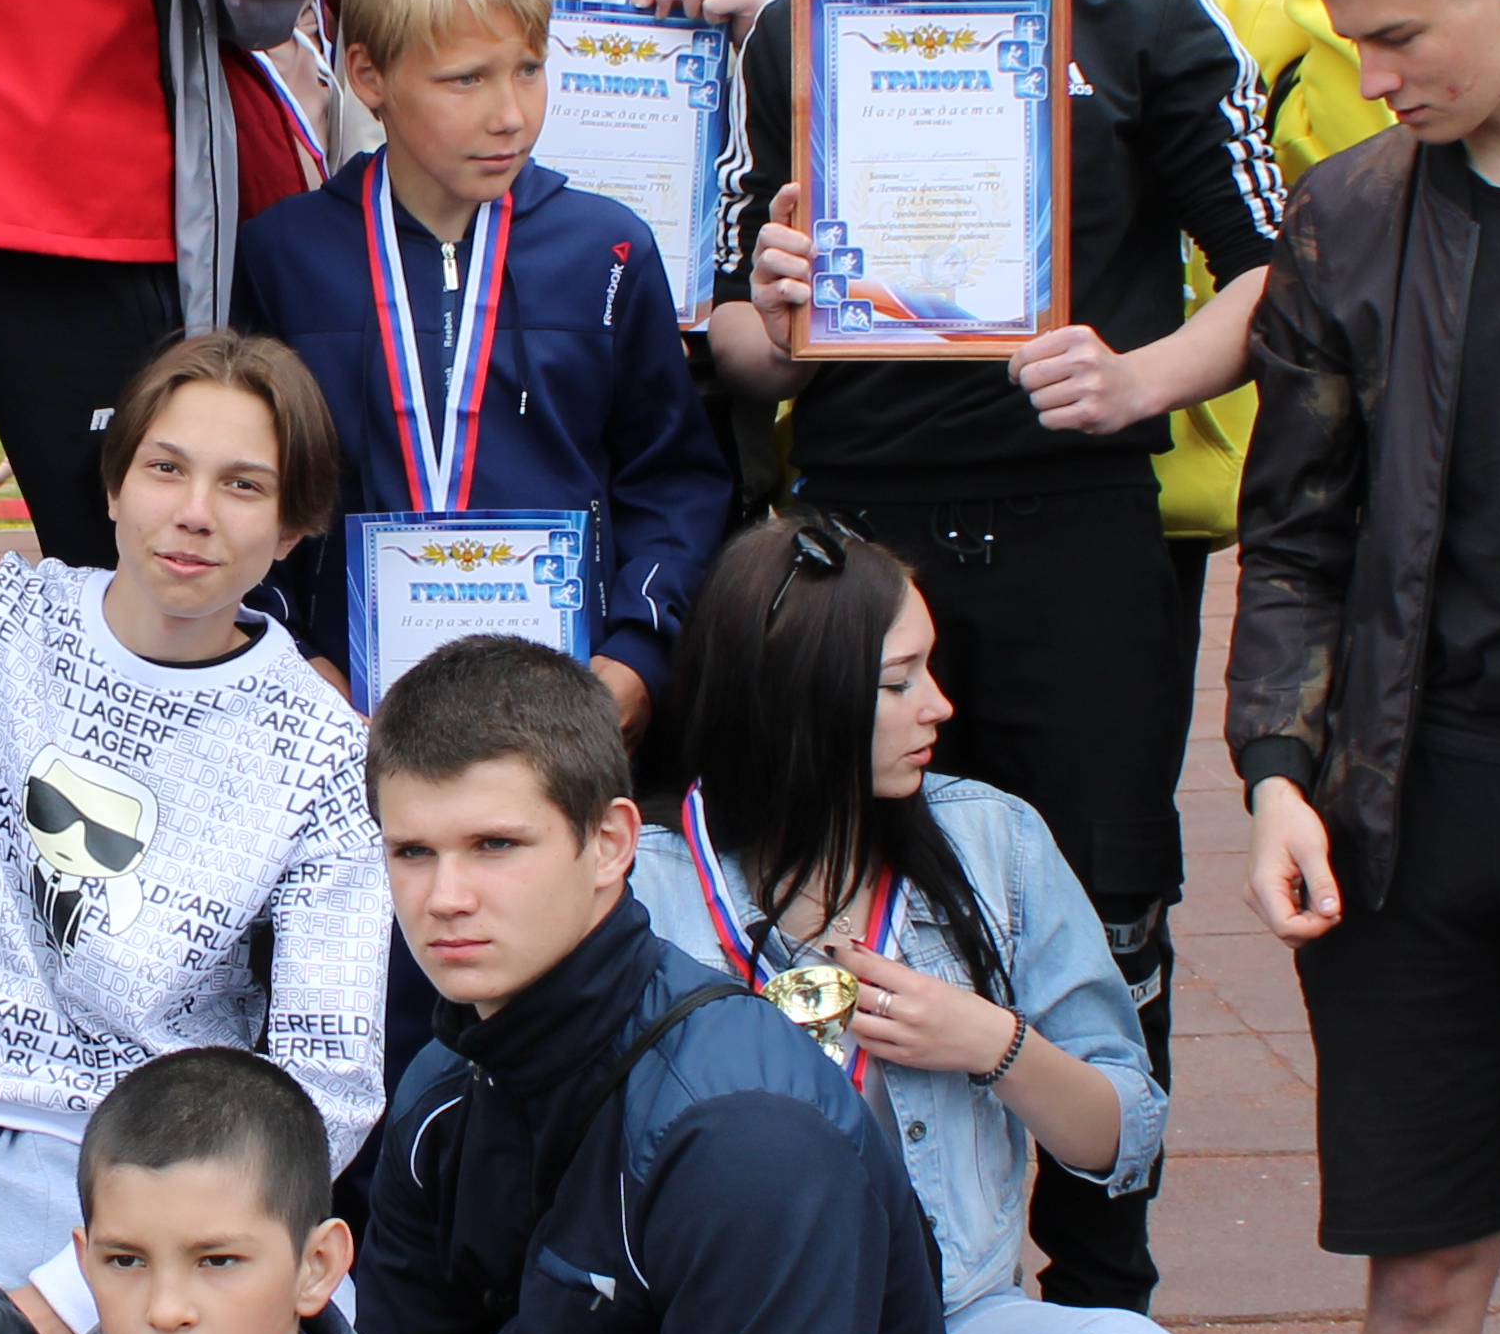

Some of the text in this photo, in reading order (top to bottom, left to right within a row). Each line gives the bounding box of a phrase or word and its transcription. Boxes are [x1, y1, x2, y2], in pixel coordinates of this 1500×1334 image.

[560, 72, 670, 99] ГРАМОТА
[870, 70, 993, 93] ГРАМОТА
[550, 104, 679, 123] Награждается
[862, 105, 1004, 120] Награждается
[597, 180, 647, 192] фестивале
[649, 183, 670, 193] ГТО
[876, 183, 917, 193] Летнем
[919, 182, 975, 194] фестивале
[977, 181, 999, 191] ГТО
[603, 263, 626, 327] Reebok
[444, 310, 453, 348] Reebok
[409, 582, 529, 603] ГРАМОТА
[400, 615, 540, 630] Награждается
